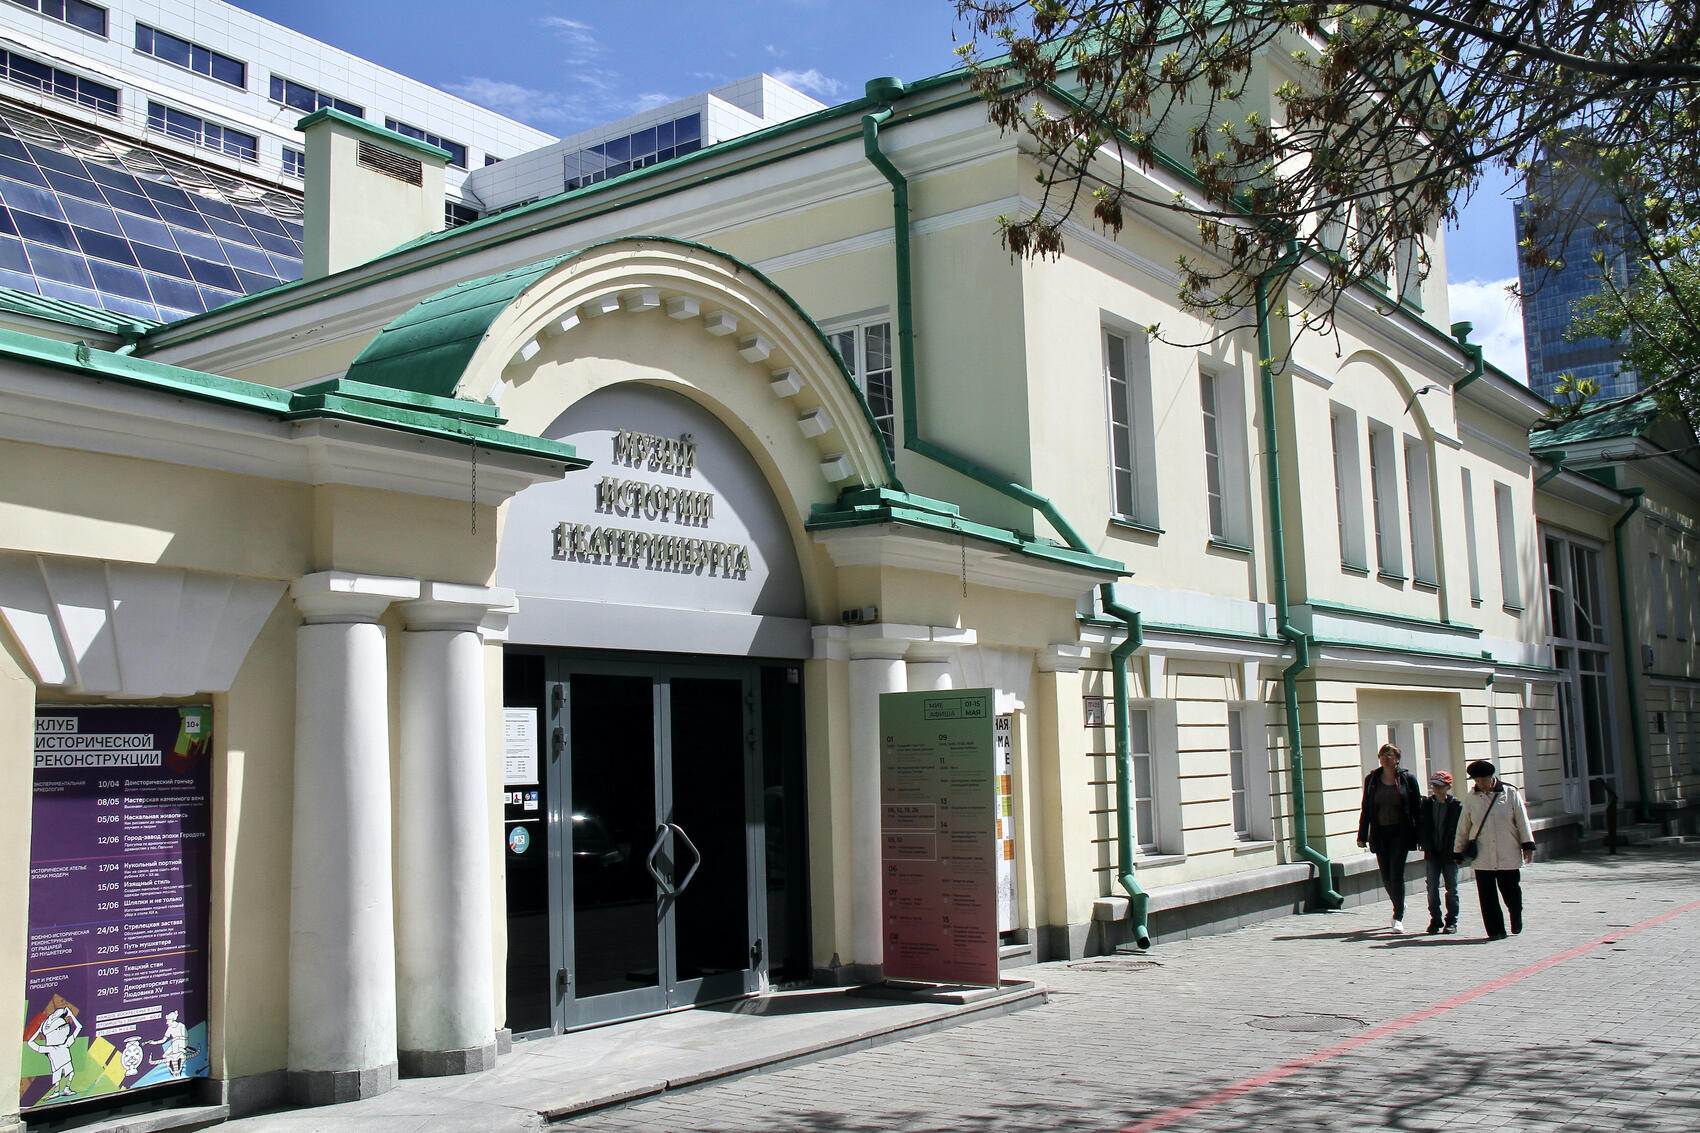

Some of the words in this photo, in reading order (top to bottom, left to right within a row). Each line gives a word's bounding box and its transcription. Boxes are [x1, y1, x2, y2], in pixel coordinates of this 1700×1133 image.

[617, 428, 699, 471] МУЗЕЙ
[600, 475, 715, 522] ИСТОРИИ
[556, 521, 753, 573] ЕКАТЕРИНБУРГА
[964, 700, 981, 708] 01-15
[35, 719, 75, 731] КЛУБ
[186, 720, 200, 729] 10+
[35, 733, 151, 748] ИСТОРИЧЕСКОЙ
[34, 753, 160, 767] РЕКОНСТРУКЦИИ
[98, 780, 120, 789] 10/04
[97, 798, 120, 807] 08/05
[97, 815, 120, 824] 05/06
[98, 836, 120, 845] 12/06
[124, 834, 161, 842] Город-завод
[98, 863, 120, 872] 17/04
[124, 861, 158, 869] Кукольный
[158, 859, 183, 867] портной
[97, 883, 120, 892] 15/05
[124, 880, 153, 888] Изящный
[97, 902, 119, 911] 12/06
[124, 899, 149, 907] Шляпки
[97, 926, 119, 935] 24/04
[124, 922, 160, 931] Стрелецкая
[97, 945, 120, 954] 22/05
[124, 943, 139, 951] Путь
[124, 963, 149, 971] Ткацкий
[97, 967, 120, 977] 01/05
[123, 980, 169, 992] Декораторская
[97, 987, 119, 997] 29/05
[123, 990, 154, 999] Людовика
